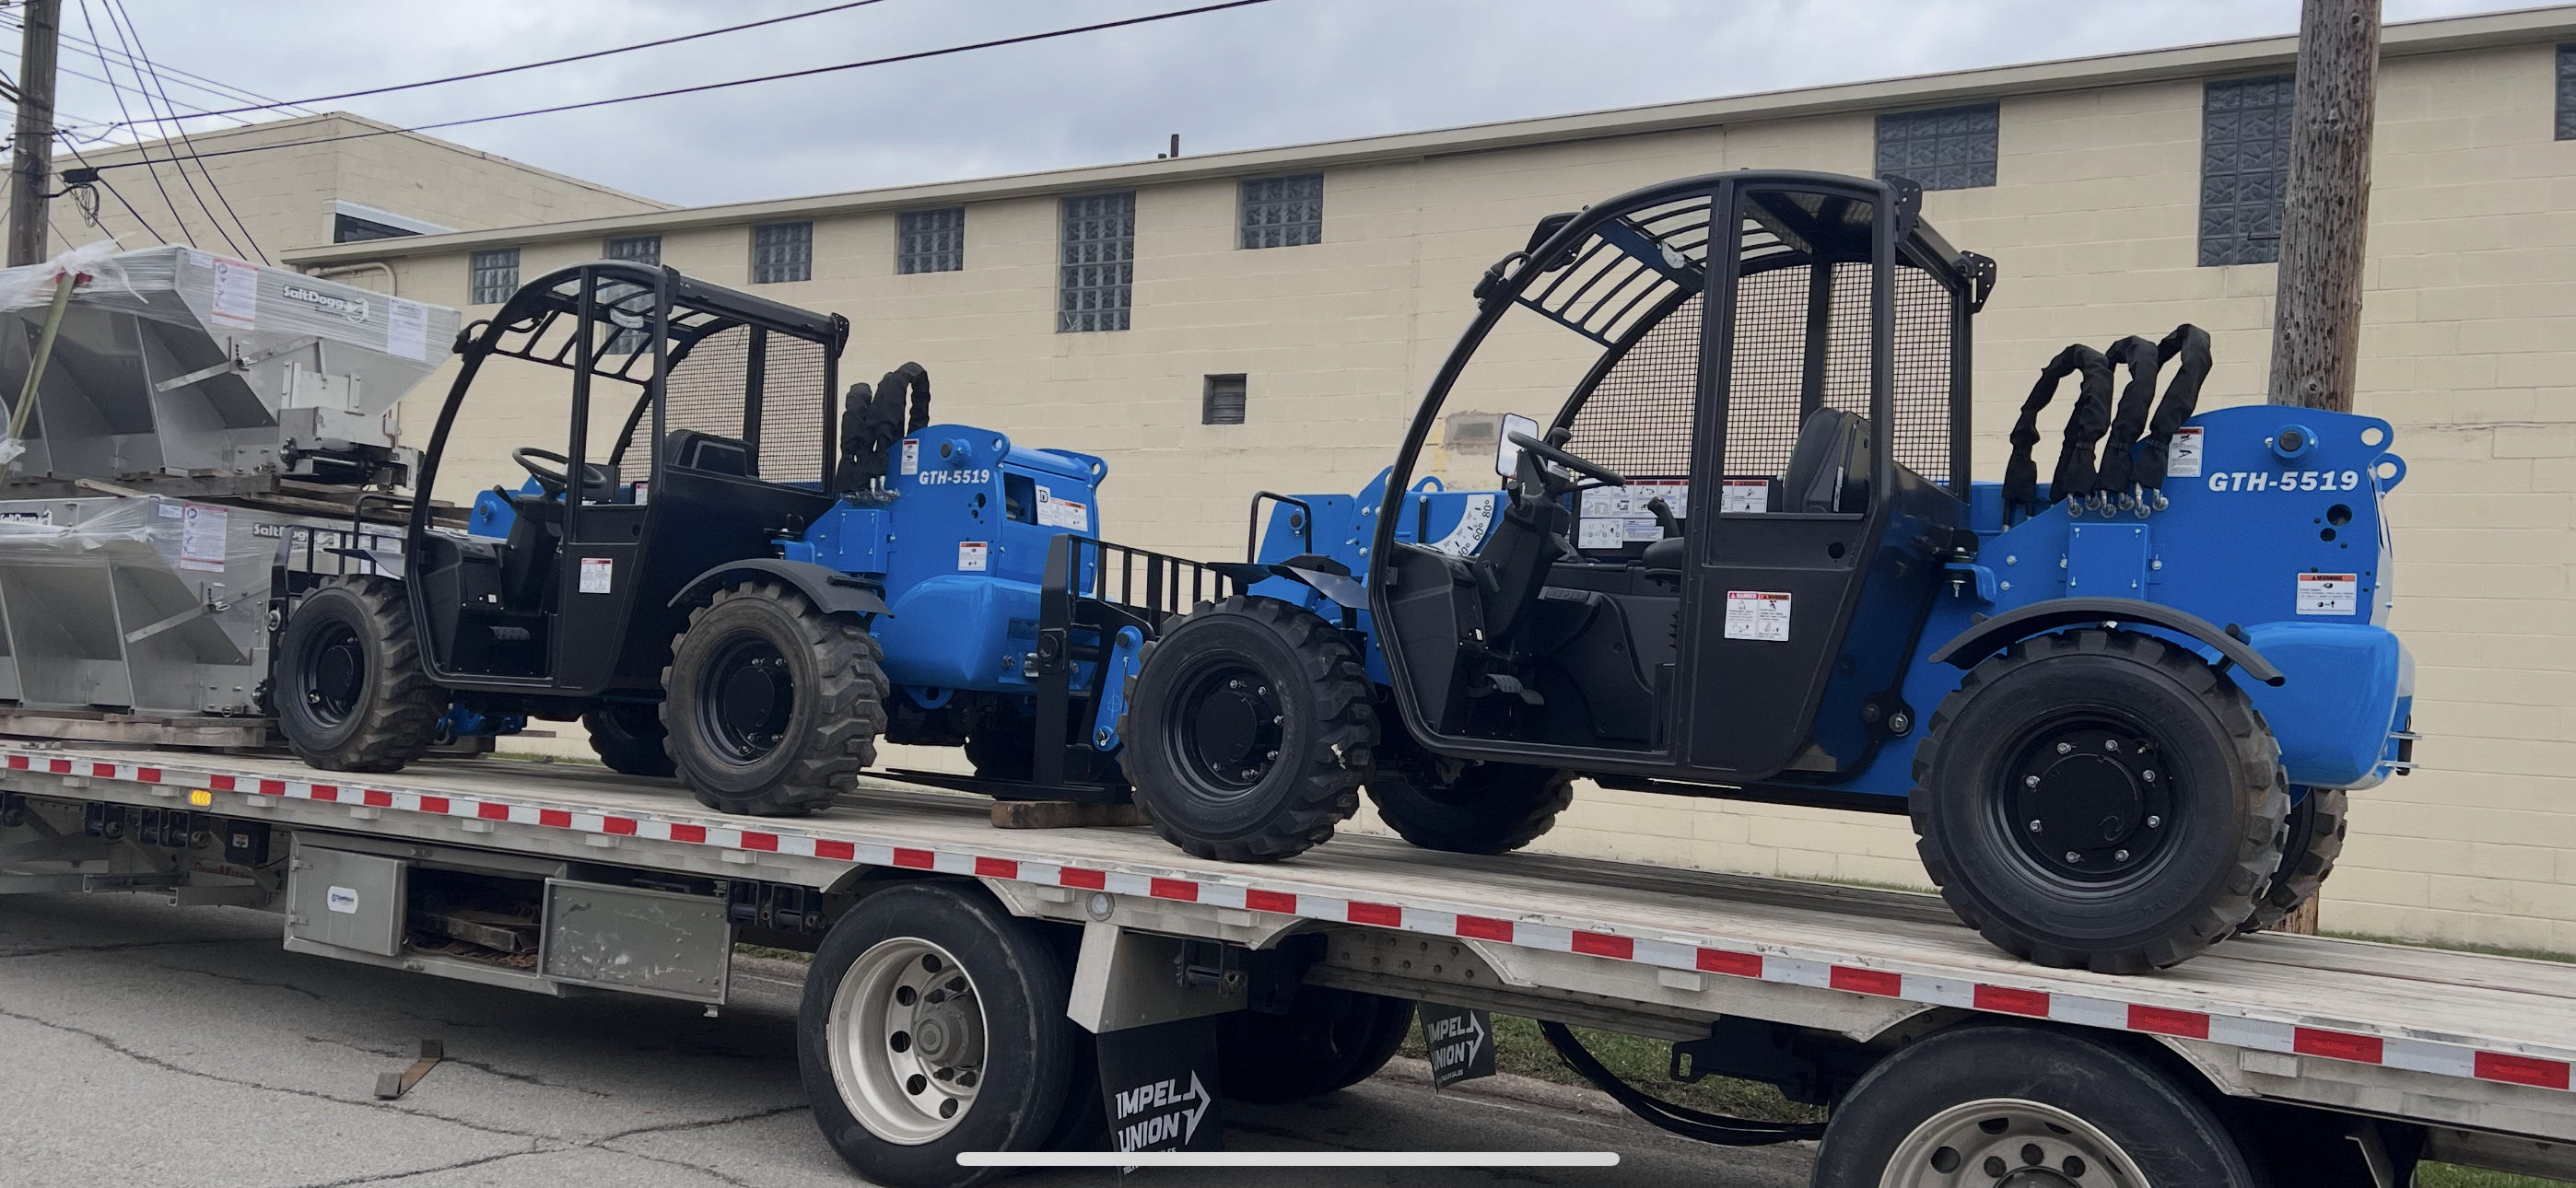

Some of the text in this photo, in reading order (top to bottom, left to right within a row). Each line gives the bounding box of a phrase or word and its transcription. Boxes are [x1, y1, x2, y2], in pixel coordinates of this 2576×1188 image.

[919, 469, 990, 485] GTH-5519
[2208, 471, 2359, 492] GTH-5519
[1427, 1016, 1466, 1044] IMPEL
[1430, 1042, 1466, 1073] UNION
[1115, 1078, 1182, 1120] IMPEL
[1118, 1112, 1180, 1153] UNION
